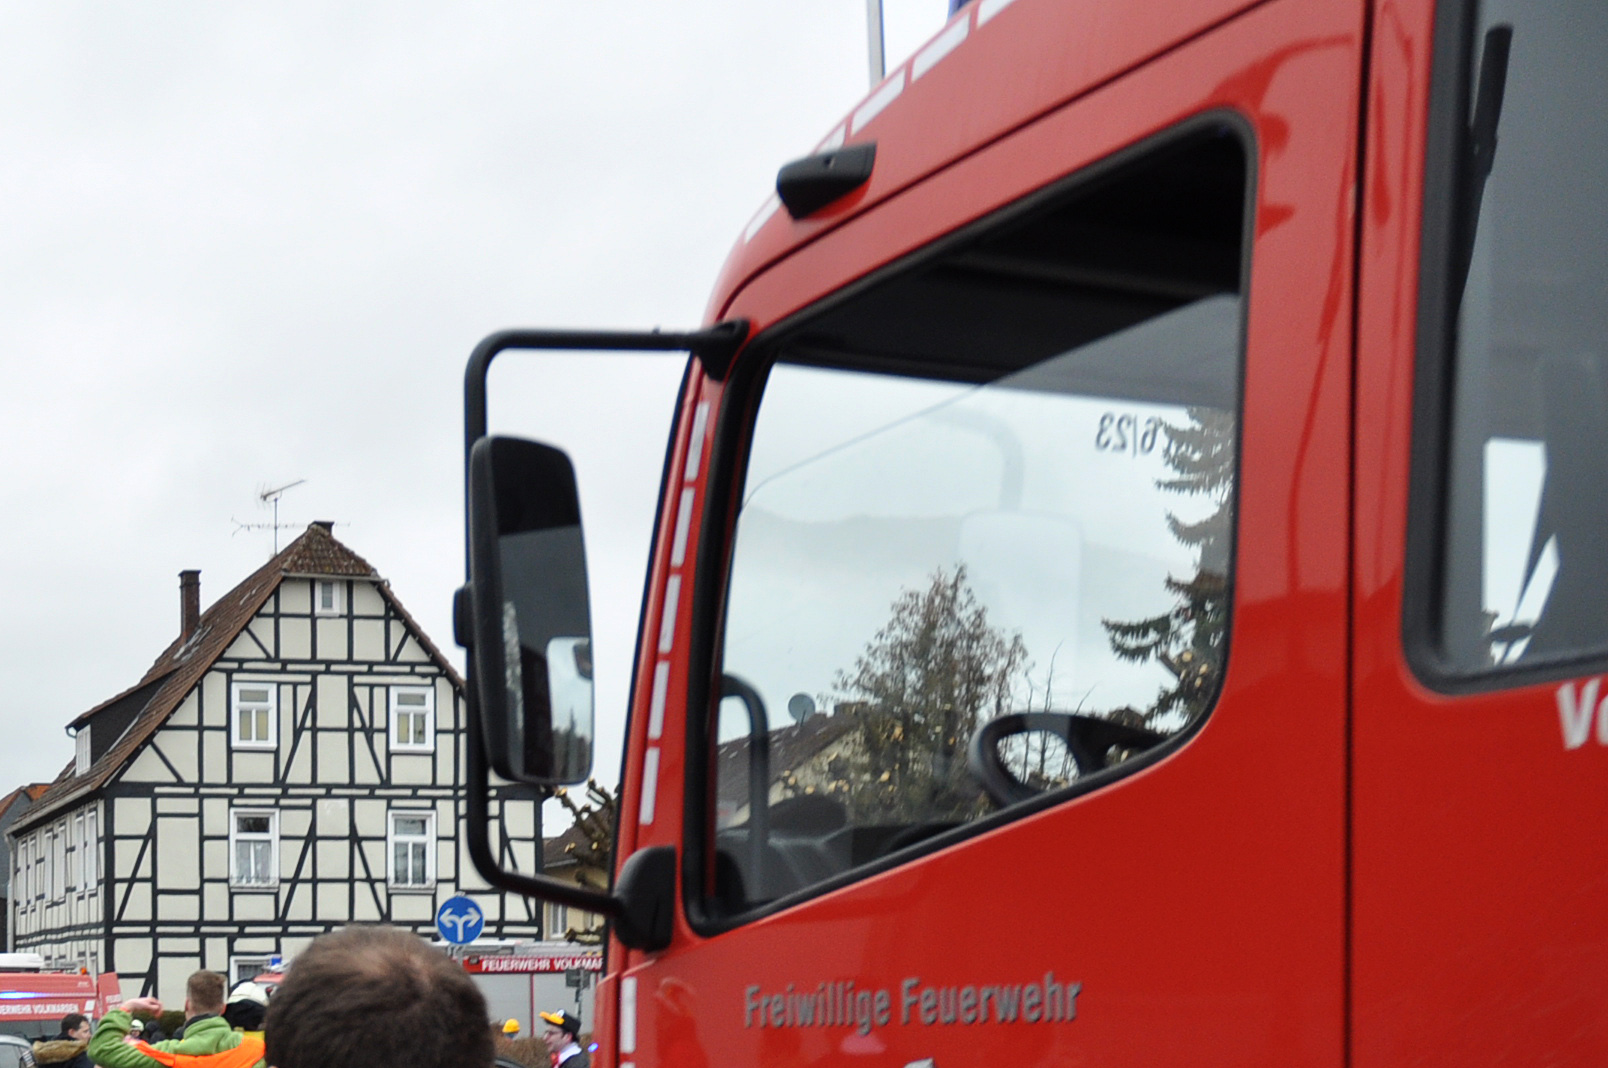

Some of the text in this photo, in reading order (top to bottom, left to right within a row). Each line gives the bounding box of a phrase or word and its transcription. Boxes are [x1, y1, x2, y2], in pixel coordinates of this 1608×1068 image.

[481, 957, 551, 971] FEUERWEHR
[745, 971, 1082, 1037] Freiwillige Feuerwehr
